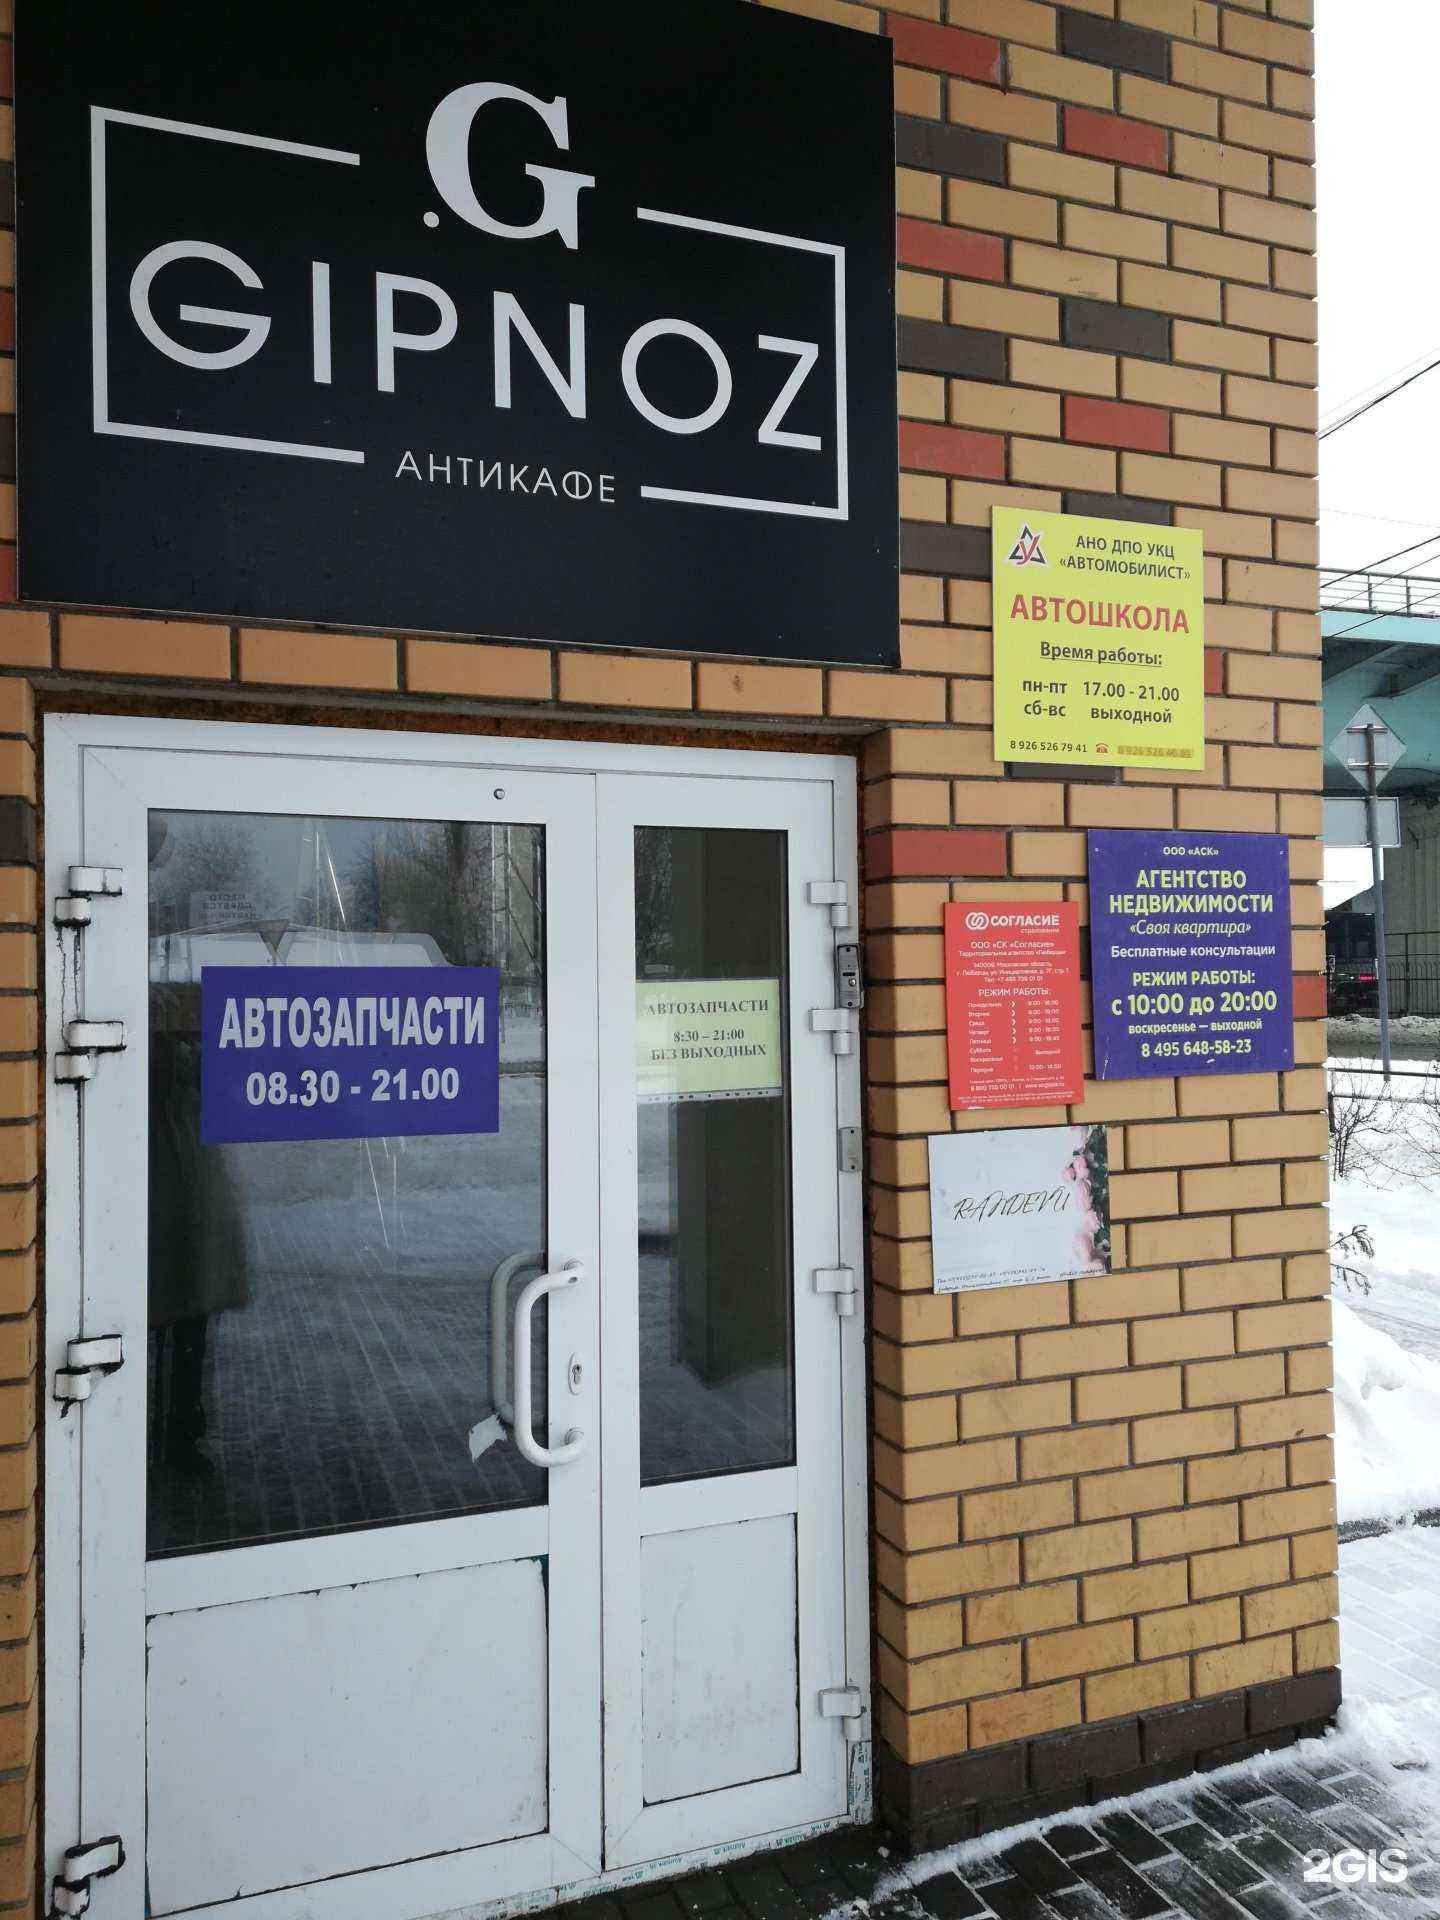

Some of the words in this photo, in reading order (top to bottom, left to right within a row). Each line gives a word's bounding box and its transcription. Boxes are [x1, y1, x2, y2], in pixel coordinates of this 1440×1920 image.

[129, 240, 822, 451] GIPNOZ
[396, 451, 616, 503] АНТИКАФЕ
[1076, 535, 1107, 550] АНО
[1112, 539, 1143, 555] ДПО
[1147, 542, 1175, 559] УКЦ
[1060, 555, 1191, 580] «АВТОМОБИЛИСТ»
[1010, 594, 1190, 634] АВТОШКОЛА
[1040, 641, 1093, 660] Время
[1098, 648, 1163, 666] работы:
[1022, 680, 1068, 694] пн-пт
[1083, 681, 1125, 698] 17.00
[1138, 685, 1179, 701] 21.00
[1024, 700, 1066, 717] сб-вс
[1090, 706, 1172, 725] выходной
[1018, 741, 1037, 751] 926
[1040, 742, 1058, 752] 526
[1061, 743, 1073, 752] 79
[1076, 743, 1088, 753] 41
[1163, 847, 1186, 856] ООО
[1188, 847, 1219, 856] «АСК»
[1136, 870, 1247, 888] АГЕНТСТВО
[1109, 895, 1273, 915] НЕДВИЖИМОСТИ
[991, 914, 1060, 926] СОГЛАСИЕ
[1130, 919, 1170, 935] «Своя
[1174, 920, 1252, 937] квартира»
[1111, 946, 1187, 958] Бесплатные
[1190, 945, 1276, 958] консультации
[1133, 971, 1187, 987] РЕЖИМ
[1191, 970, 1256, 985] РАБОТЫ:
[979, 988, 1010, 997] РЕЖИМ
[647, 1000, 768, 1015] АВТОЗАПЧАСТИ
[1127, 994, 1184, 1015] 10:00
[1189, 997, 1215, 1016] до
[1220, 991, 1277, 1012] 20:00
[219, 996, 485, 1048] АВТОЗАПЧАСТИ
[1128, 1022, 1196, 1035] воскресенье
[1210, 1018, 1263, 1032] выходной
[674, 1031, 698, 1042] 8:30
[713, 1029, 744, 1040] 21:00
[681, 1044, 766, 1059] ВЫХОДНЫХ
[1141, 1043, 1151, 1057] 8
[1153, 1042, 1180, 1056] 495
[1183, 1039, 1252, 1055] 648-58-23
[247, 1070, 339, 1106] 08.30
[372, 1068, 459, 1101] 21.00
